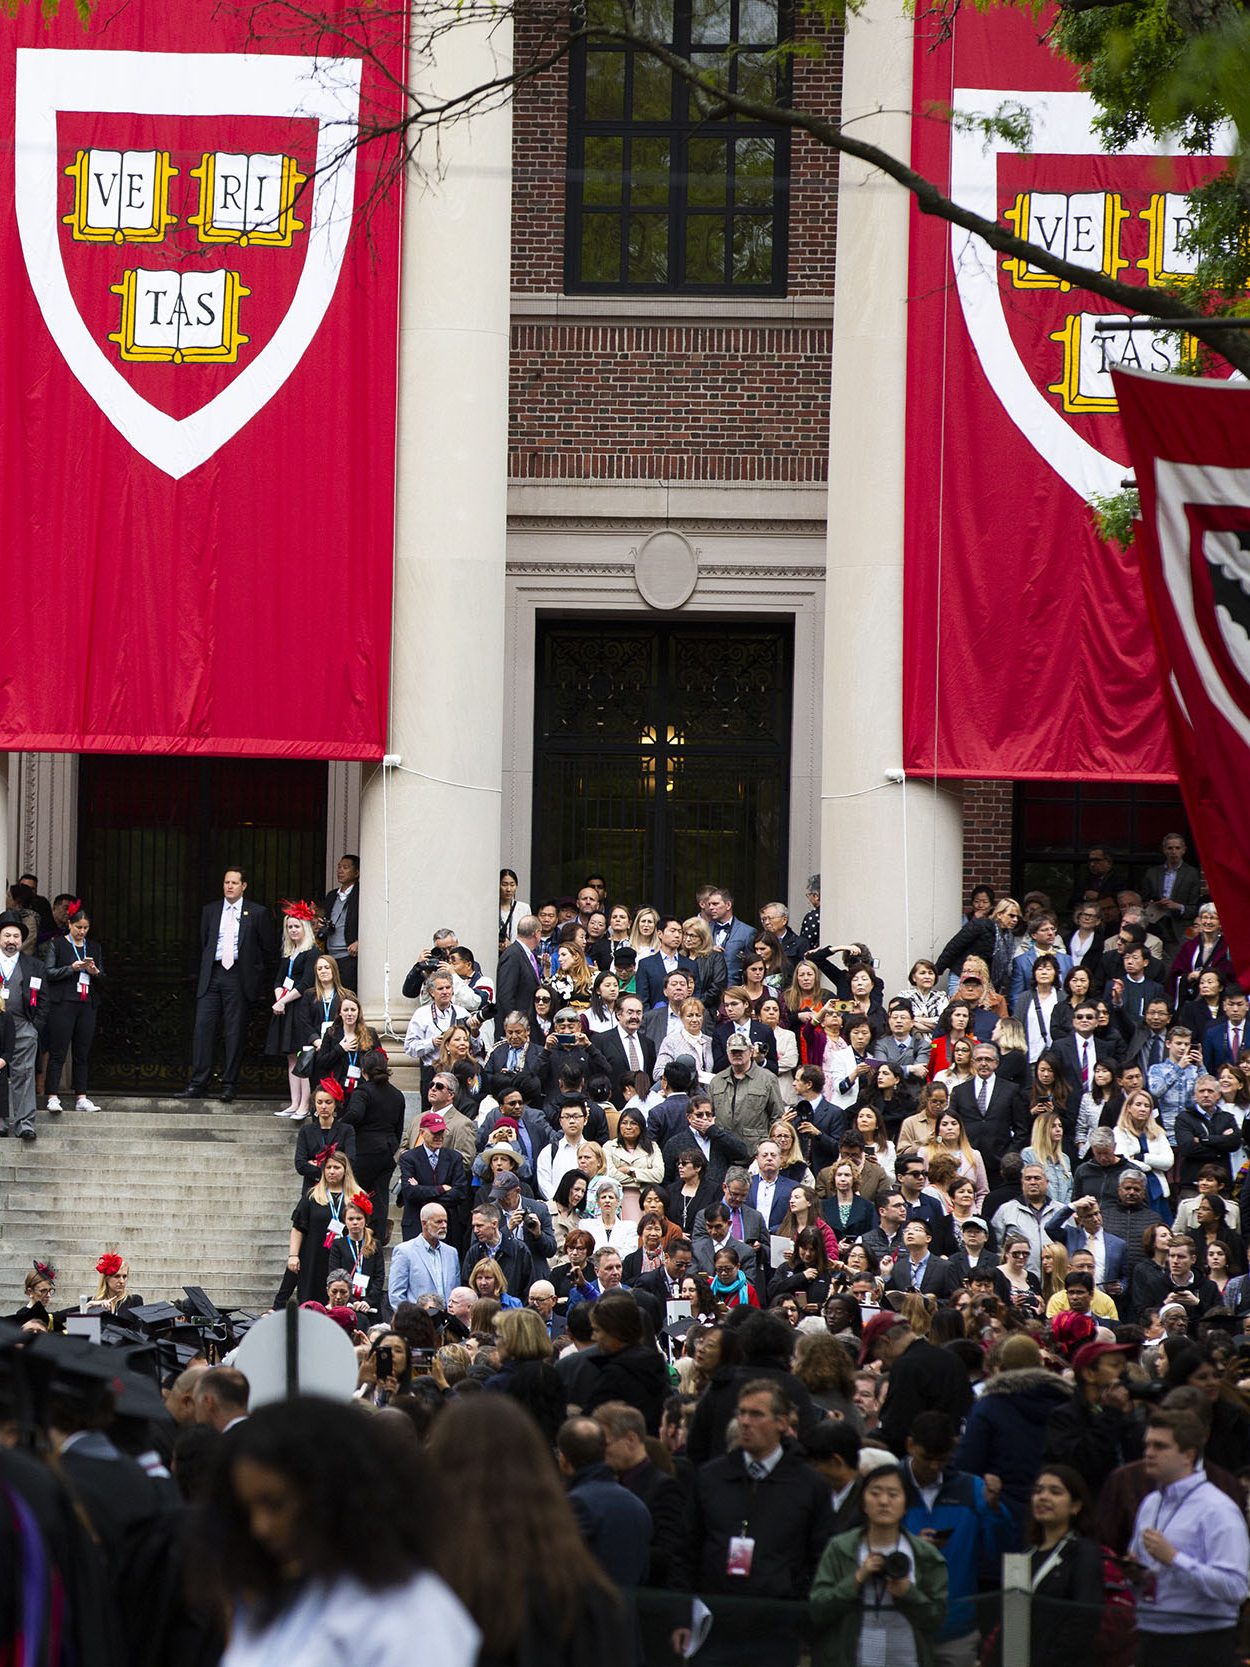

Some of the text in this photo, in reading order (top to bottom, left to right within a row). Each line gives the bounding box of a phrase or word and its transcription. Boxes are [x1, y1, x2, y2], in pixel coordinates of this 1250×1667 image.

[94, 172, 267, 211] VE RI
[1034, 215, 1095, 252] VE
[145, 290, 215, 326] TAS
[1091, 334, 1171, 374] TAS
